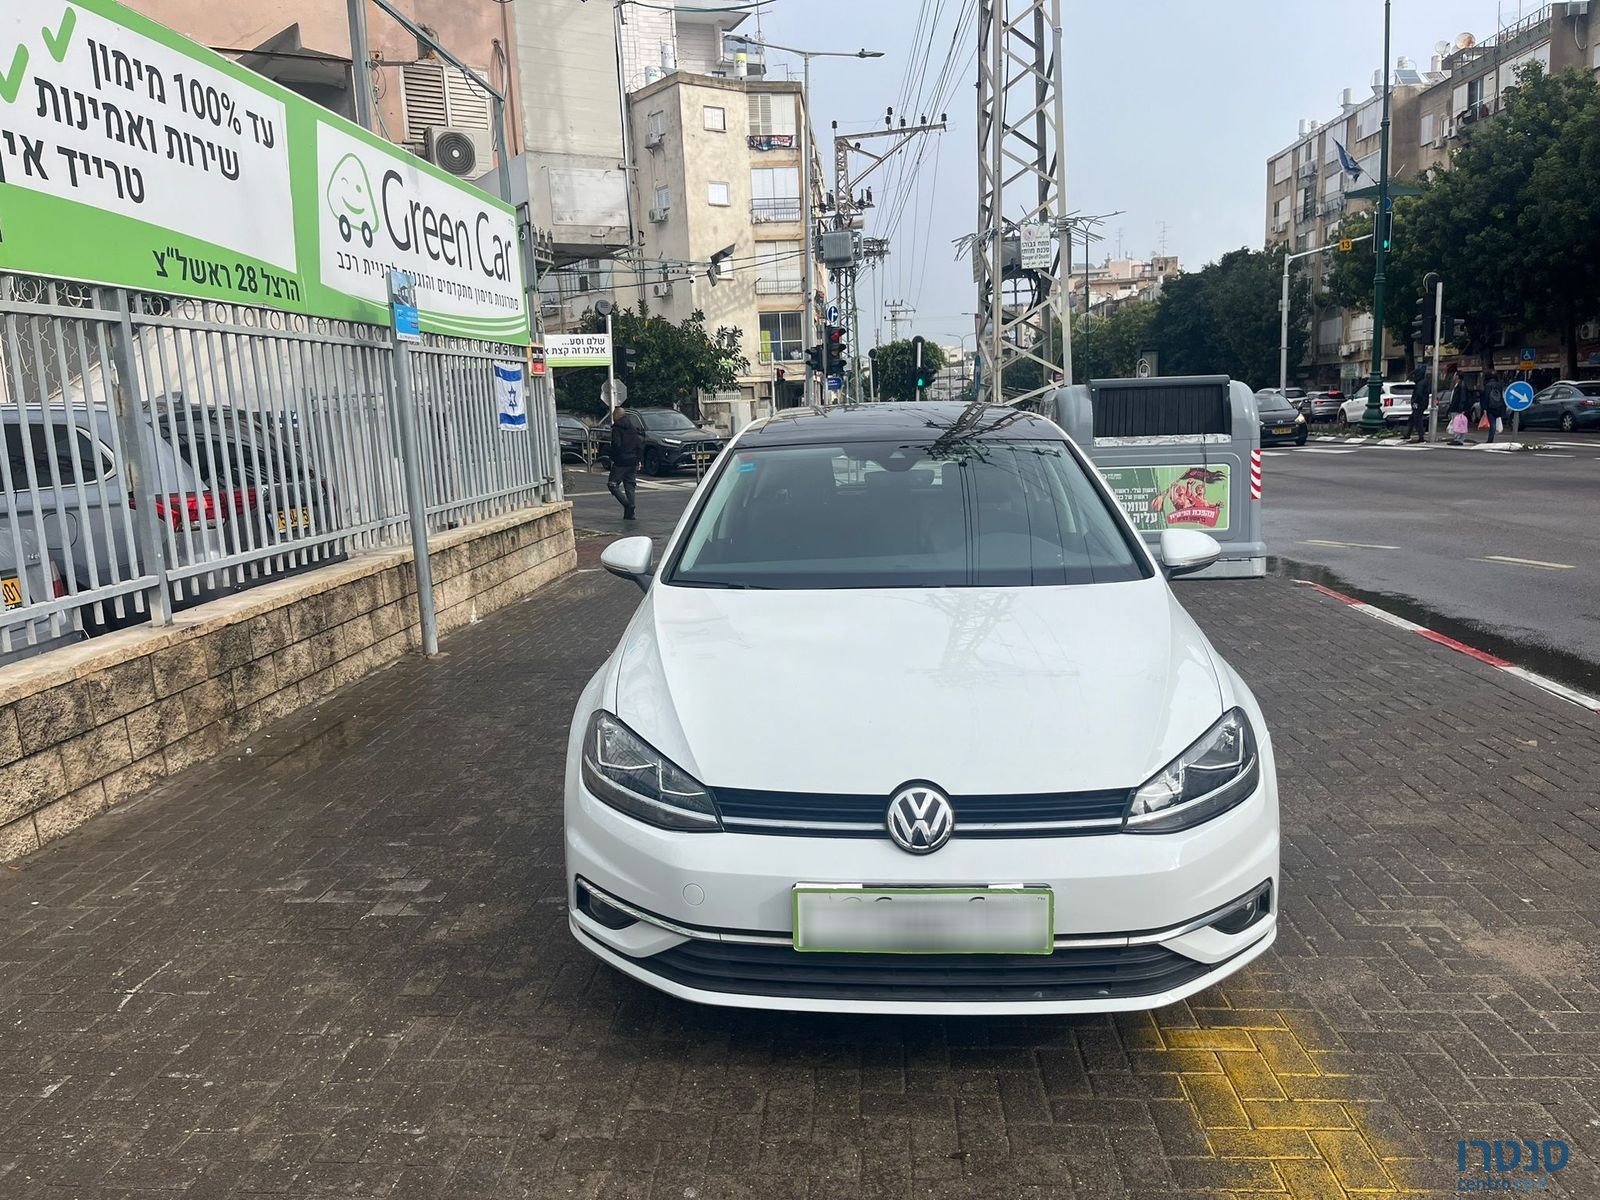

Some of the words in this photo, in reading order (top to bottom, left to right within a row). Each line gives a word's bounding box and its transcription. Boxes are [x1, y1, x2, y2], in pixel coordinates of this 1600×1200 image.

[87, 38, 166, 104] מימון
[34, 76, 158, 154] ואמינות
[173, 73, 242, 135] 100%
[246, 109, 275, 149] עד
[0, 129, 49, 184] אי
[165, 125, 240, 181] שירות
[56, 145, 145, 204] טרייד
[382, 169, 472, 271] Green
[475, 211, 512, 282] Car
[1341, 240, 1350, 249] 13
[337, 251, 359, 273] רכב
[235, 263, 258, 294] 28
[260, 267, 301, 302] הרצל
[437, 278, 473, 301] מתקדמים
[474, 287, 493, 304] מימון
[494, 293, 519, 310] פתרונות
[551, 346, 569, 356] קצת
[561, 337, 584, 346] וסע...
[571, 347, 581, 355] זה
[583, 345, 606, 354] אצלנו
[586, 336, 605, 345] שלם
